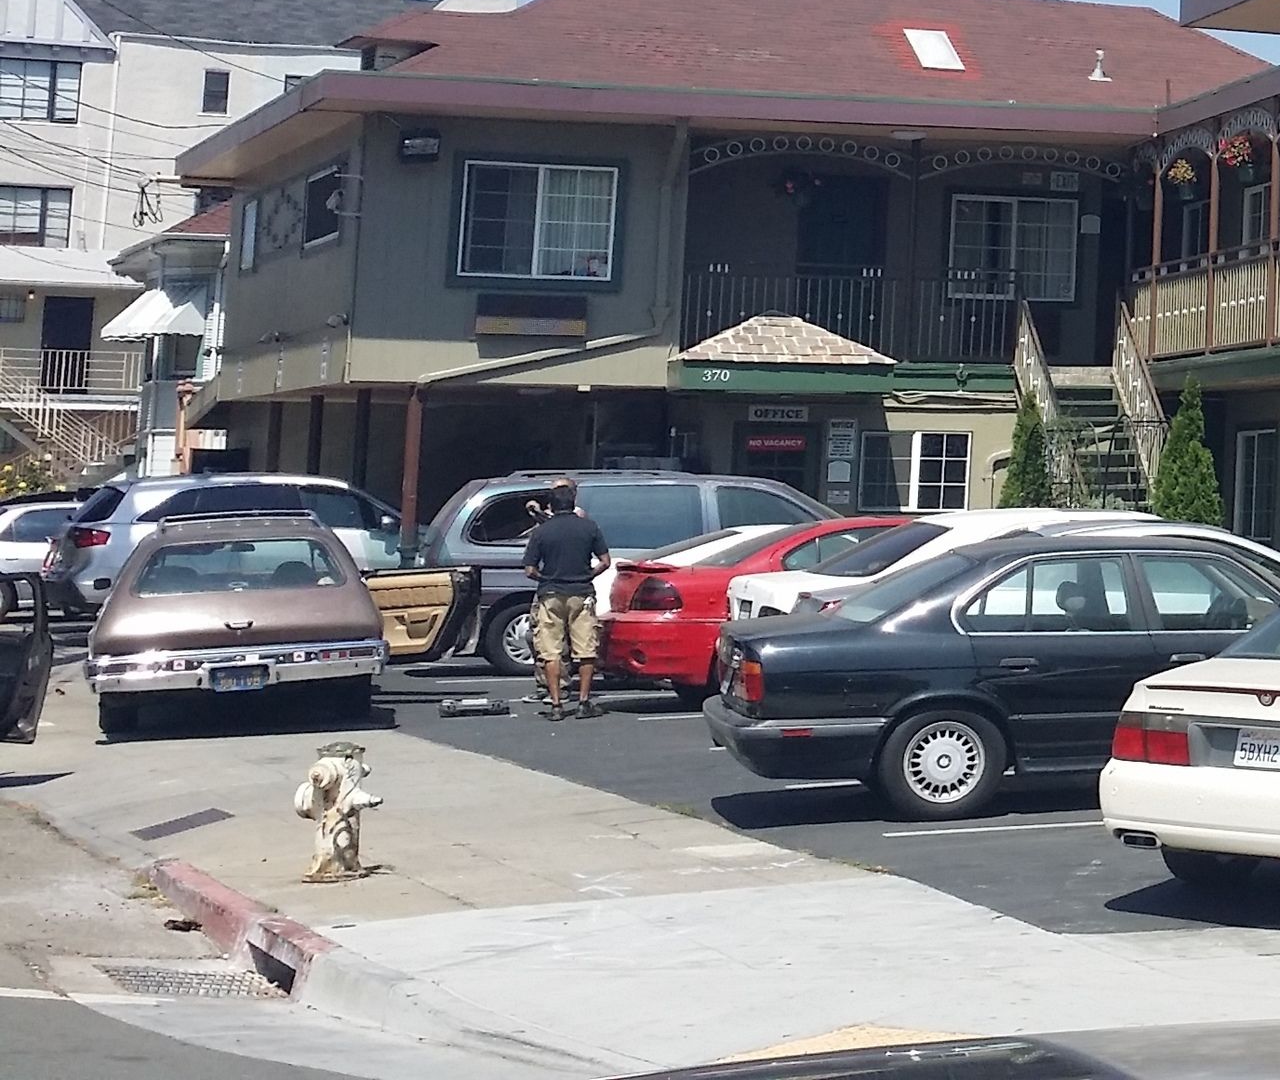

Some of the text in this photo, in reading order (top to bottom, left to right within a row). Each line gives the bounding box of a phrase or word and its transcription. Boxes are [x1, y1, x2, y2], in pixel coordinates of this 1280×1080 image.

[702, 370, 731, 382] 370
[753, 409, 804, 419] OFFICE
[749, 439, 803, 447] NO VACANCY
